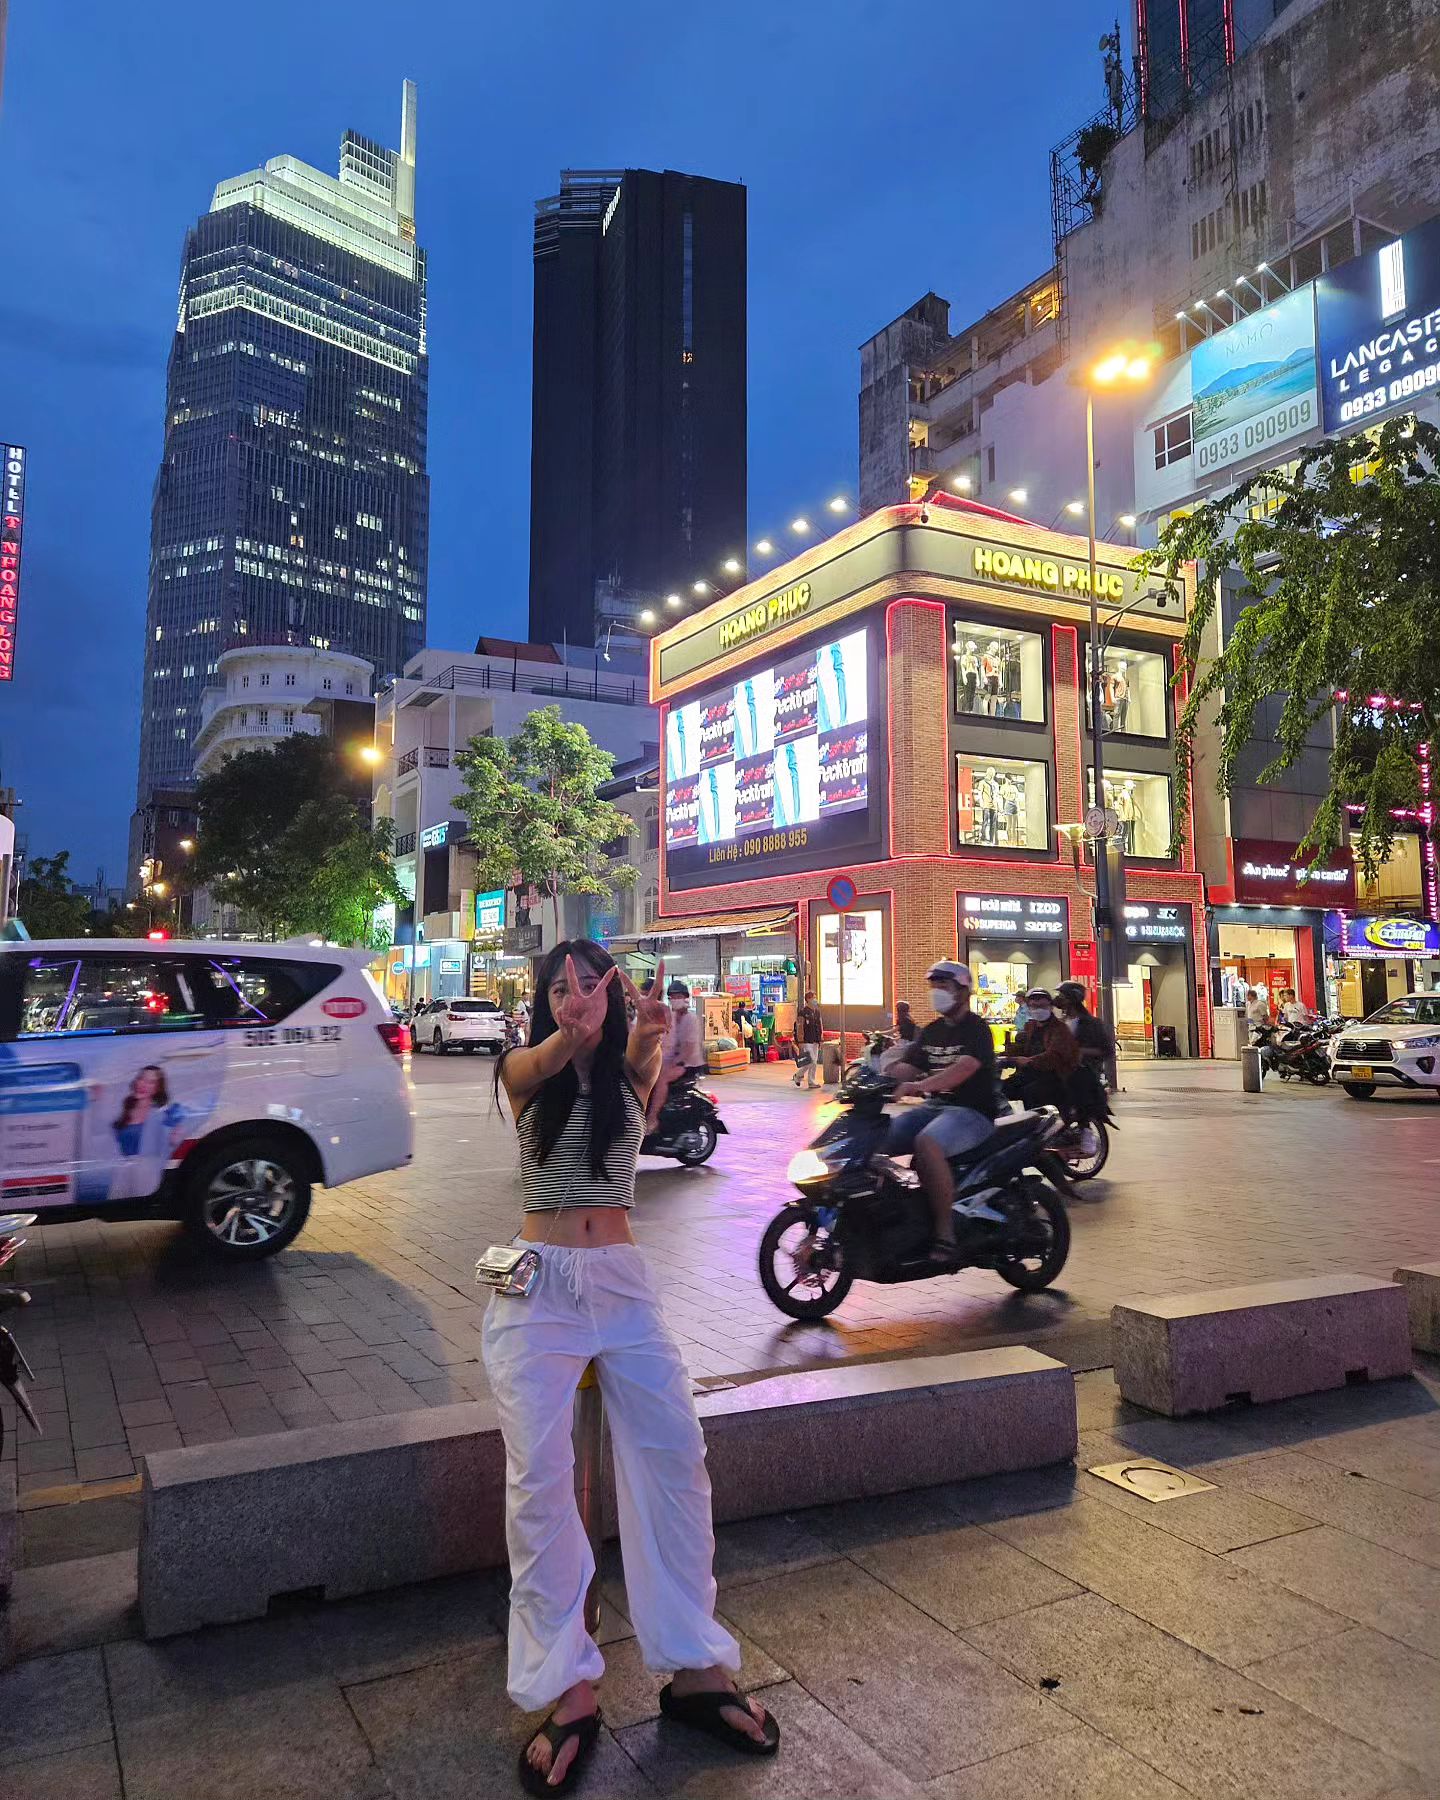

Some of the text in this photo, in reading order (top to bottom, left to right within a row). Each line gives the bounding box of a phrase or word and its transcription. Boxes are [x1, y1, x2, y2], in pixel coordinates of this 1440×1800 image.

[1341, 386, 1387, 421] 0933
[1200, 398, 1311, 468] 0933 090909
[7, 447, 22, 513] HOTEL
[974, 548, 1124, 598] HOANG PHUC
[719, 582, 811, 646] HOANG PHUC
[744, 839, 761, 857] 090
[763, 835, 787, 854] 8888
[789, 828, 808, 848] 955
[1029, 901, 1061, 915] IZOD
